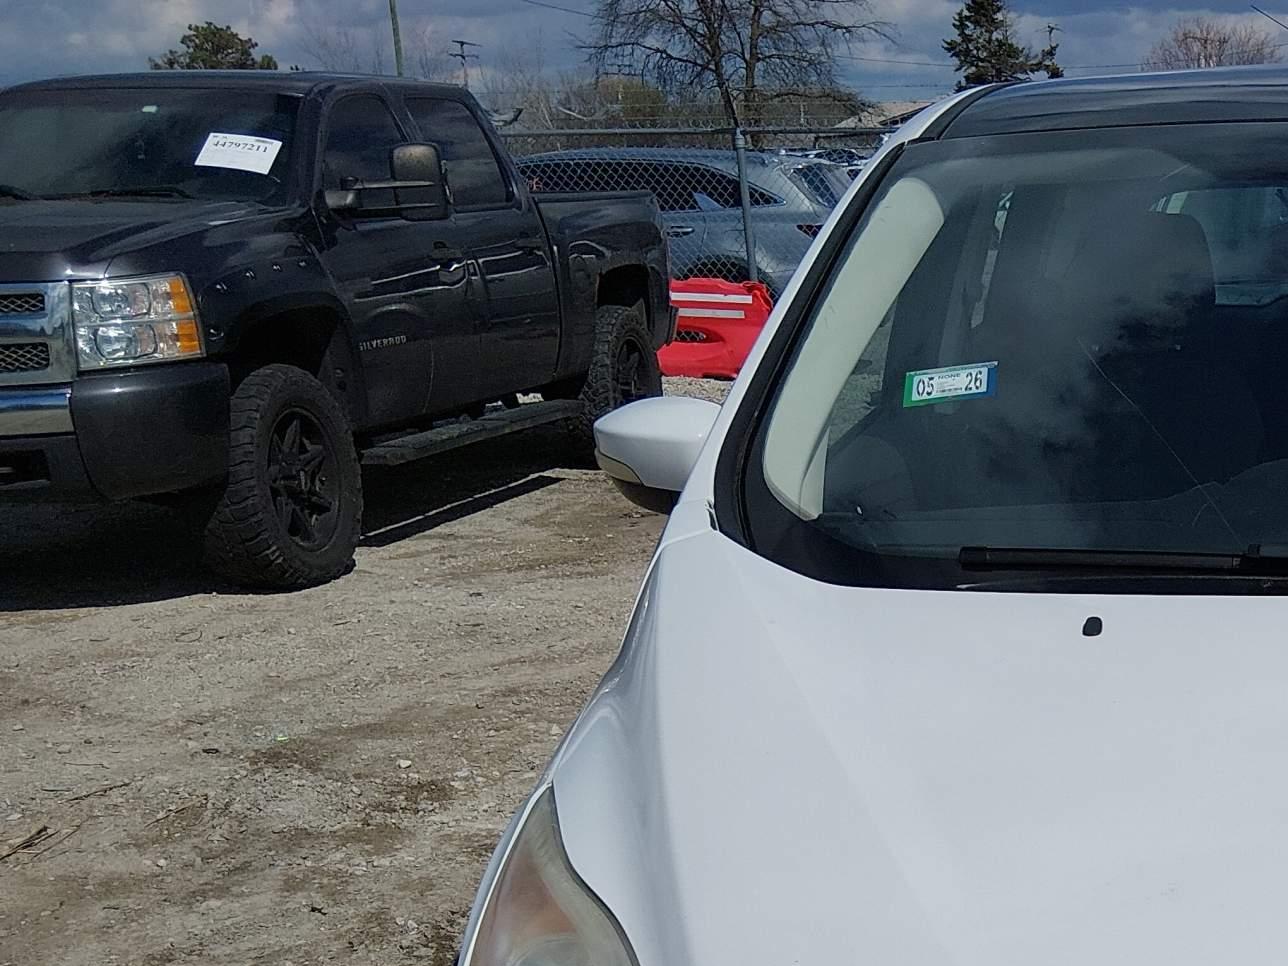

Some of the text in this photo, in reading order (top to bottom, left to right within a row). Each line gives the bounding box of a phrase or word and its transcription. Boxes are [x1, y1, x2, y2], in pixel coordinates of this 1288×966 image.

[213, 140, 268, 153] 44797211
[916, 376, 935, 397] 05
[964, 369, 983, 392] 26
